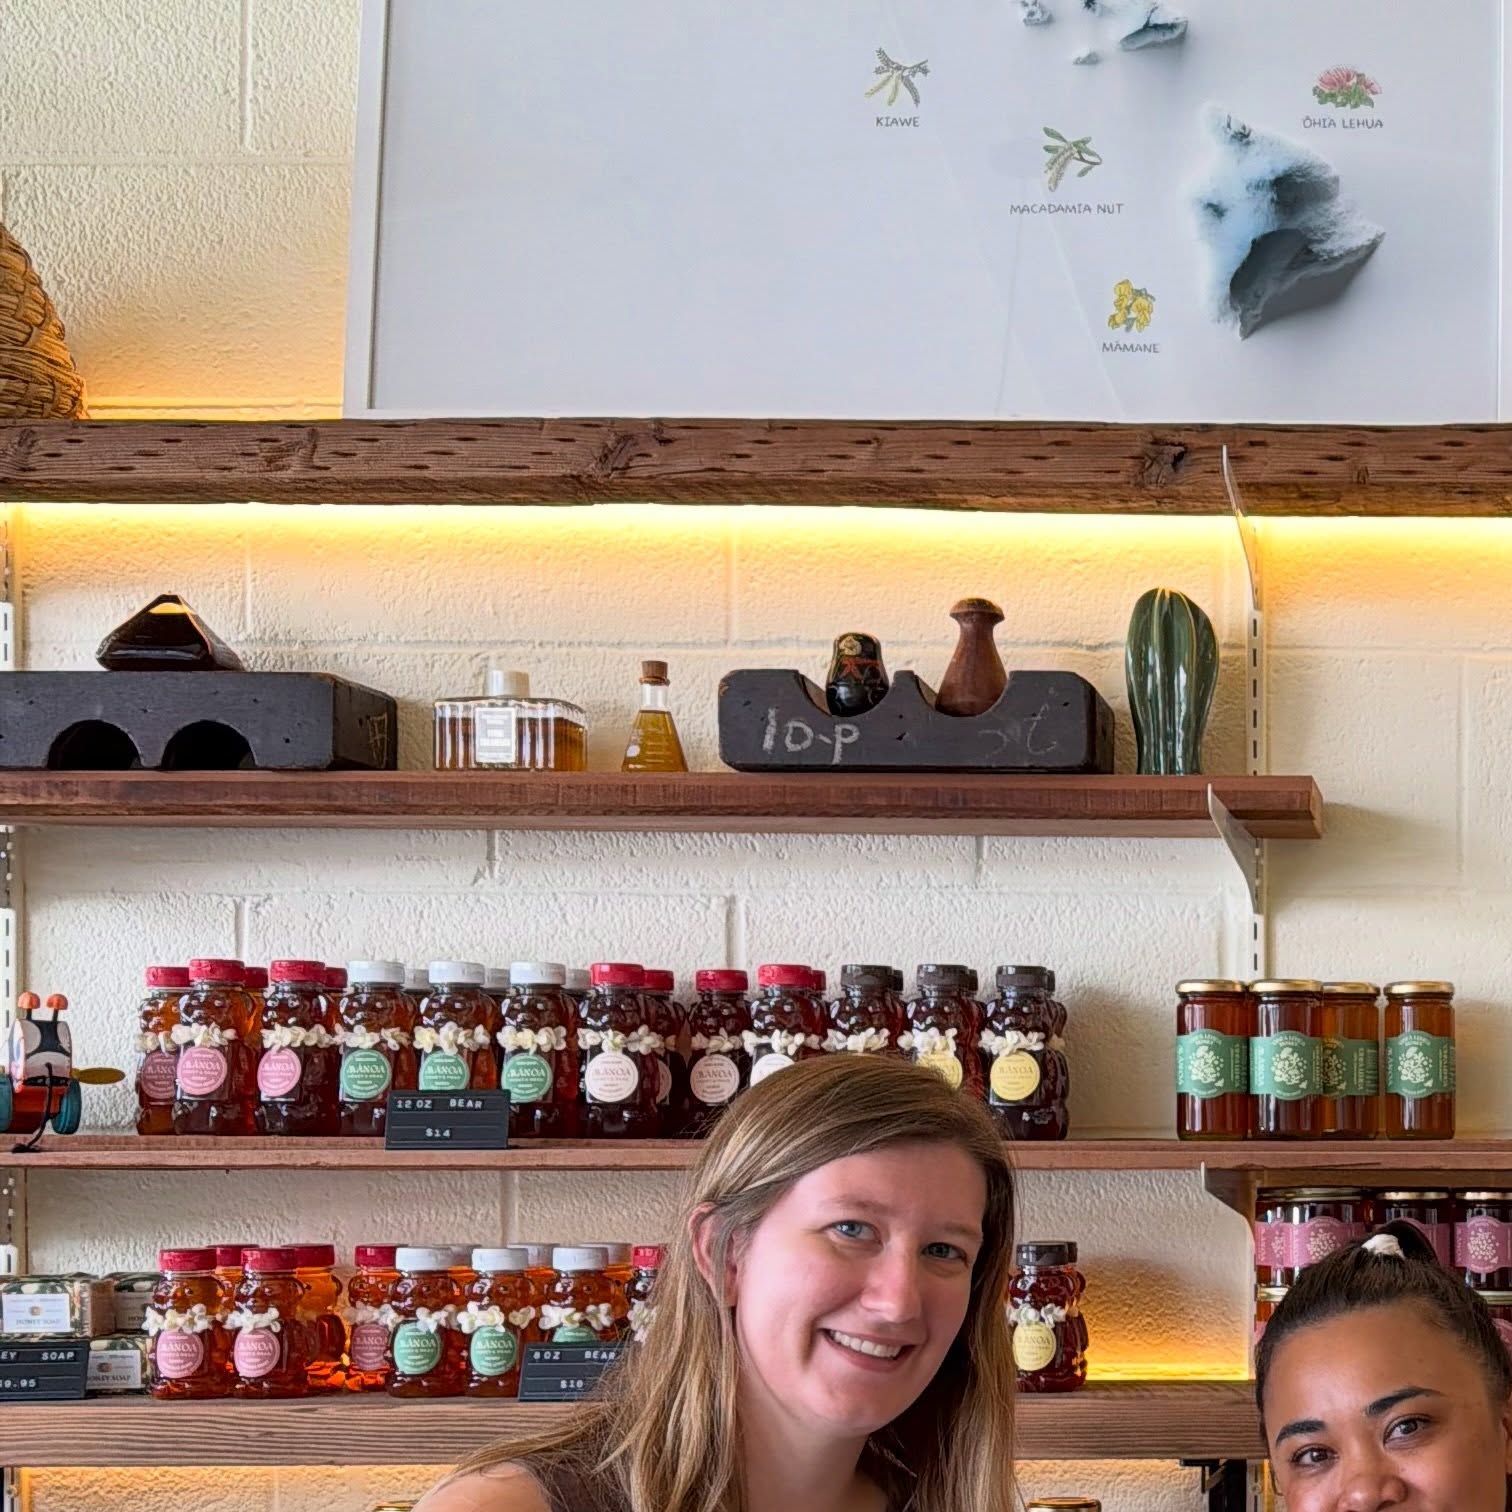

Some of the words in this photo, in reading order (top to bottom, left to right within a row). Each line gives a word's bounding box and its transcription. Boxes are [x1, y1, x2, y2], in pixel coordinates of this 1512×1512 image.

[876, 116, 920, 127] KIAWE
[1342, 118, 1383, 129] LEHUA
[1010, 203, 1092, 214] MACADAMIA
[1096, 203, 1125, 214] NUT
[397, 1100, 412, 1109] 12
[416, 1100, 432, 1109] OZ
[449, 1098, 482, 1109] BEAR
[425, 1127, 451, 1137] $14
[41, 1351, 75, 1360] SOAP
[533, 1351, 540, 1360] 8
[543, 1351, 561, 1360] OZ
[584, 1351, 616, 1361] BEAR
